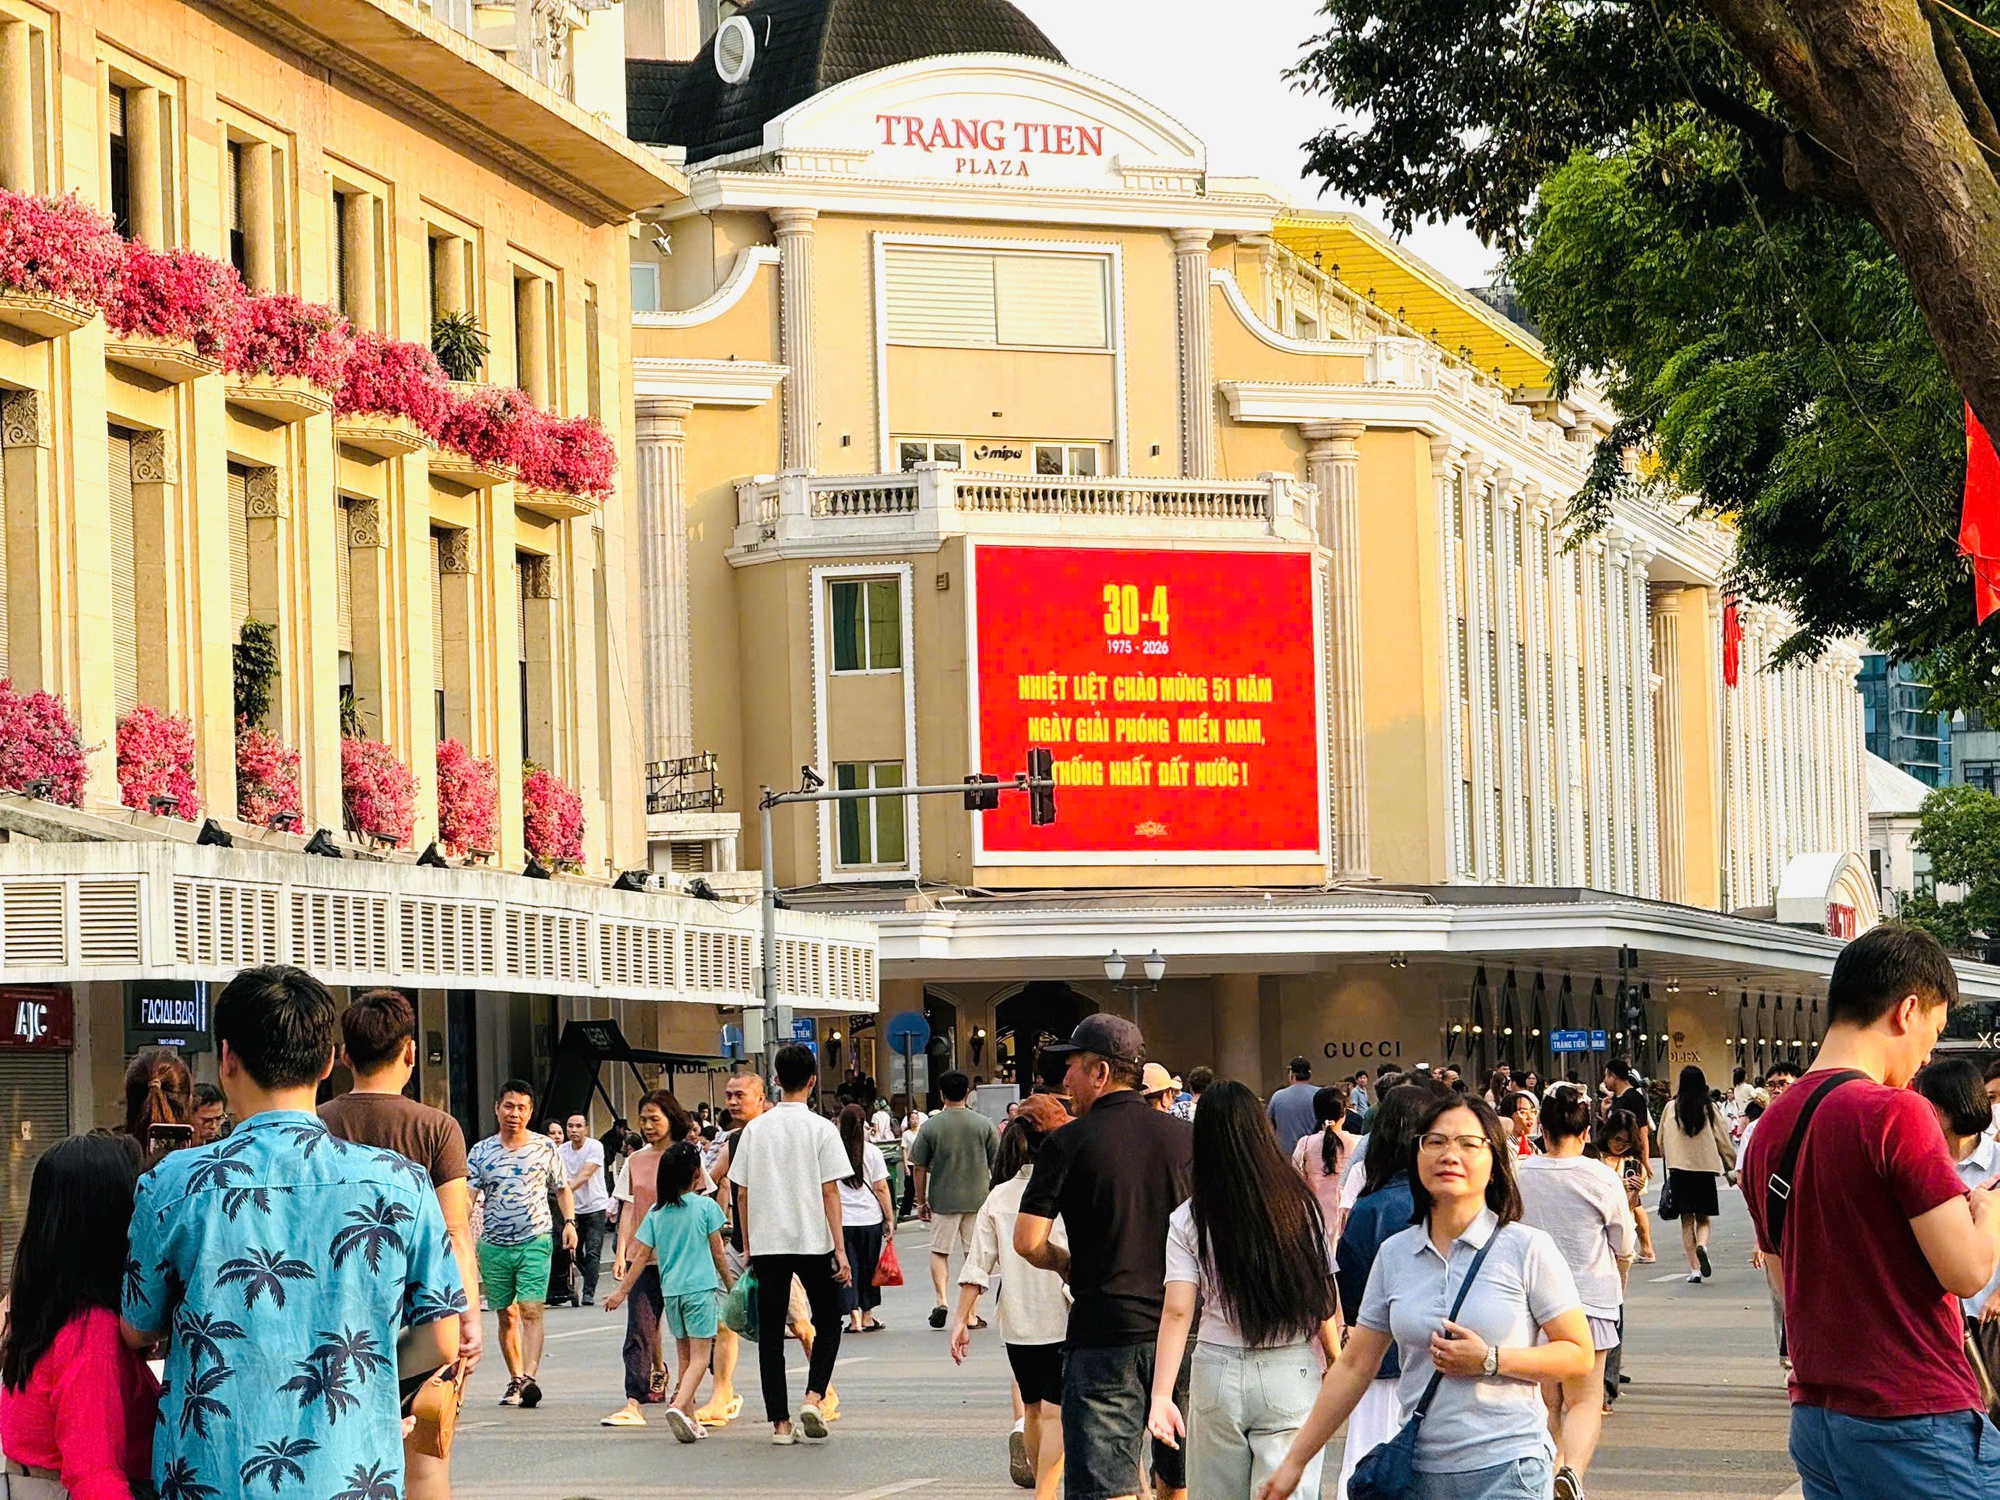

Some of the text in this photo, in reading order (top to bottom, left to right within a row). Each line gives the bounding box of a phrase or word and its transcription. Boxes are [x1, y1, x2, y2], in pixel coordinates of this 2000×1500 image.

[876, 114, 1104, 156] TRANG TIEN
[955, 157, 1030, 177] PLAZA
[1103, 584, 1169, 636] 30-4
[1107, 639, 1132, 654] 1975
[1142, 640, 1169, 655] 2026
[1018, 670, 1272, 706] NHIỆT LIỆT CHÀO MỪNG 51 NĂM
[1028, 710, 1266, 746] NGÀY GIẢI PHÓNG MIỀN NAM,
[1051, 753, 1104, 786] THỐNG
[1109, 754, 1153, 787] NHẤT
[1157, 754, 1190, 787] ĐẤT
[13, 1000, 48, 1043] AJC
[1324, 1041, 1401, 1058] GUCCI
